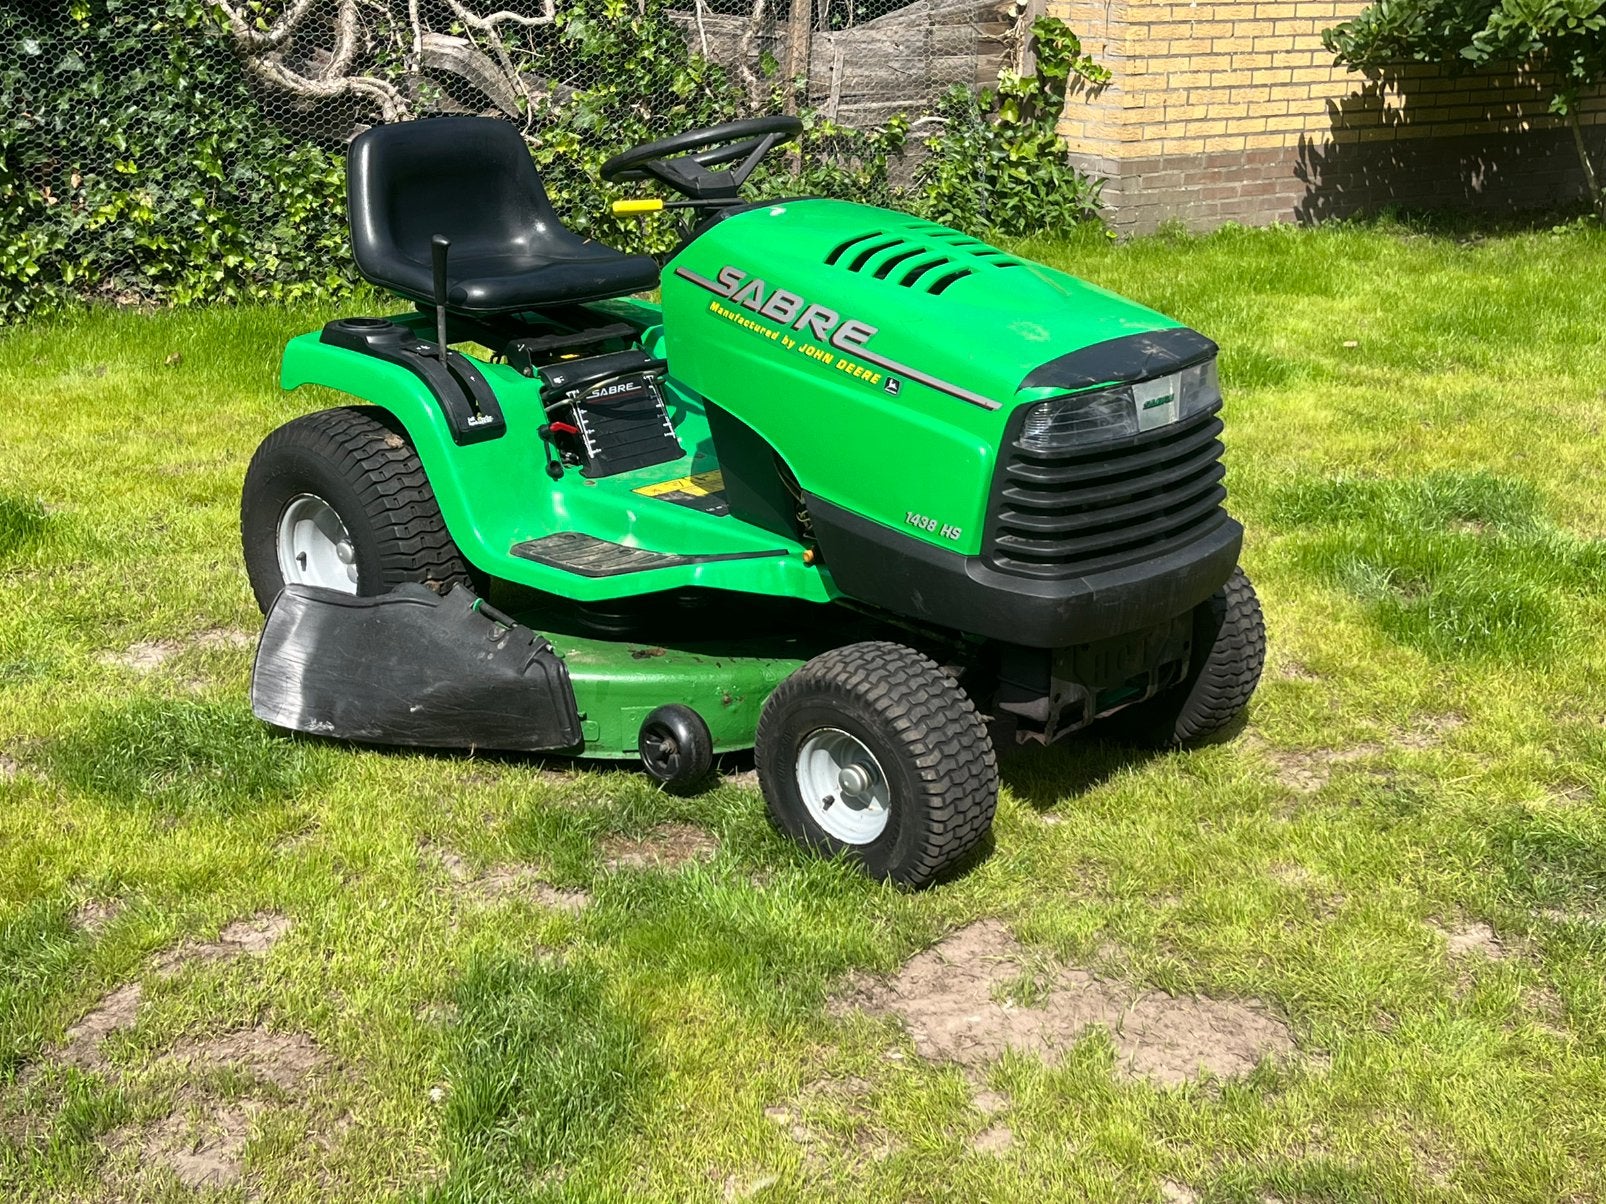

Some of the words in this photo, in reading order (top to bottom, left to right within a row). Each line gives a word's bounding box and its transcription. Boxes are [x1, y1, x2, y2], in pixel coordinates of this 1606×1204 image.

[715, 265, 879, 348] SABRE
[709, 301, 780, 341] Manufactured
[781, 334, 796, 350] by
[798, 343, 835, 365] JOHN
[835, 358, 882, 385] DEERE
[591, 382, 634, 397] SABRE
[904, 511, 938, 532] 1438
[938, 523, 963, 540] HS
